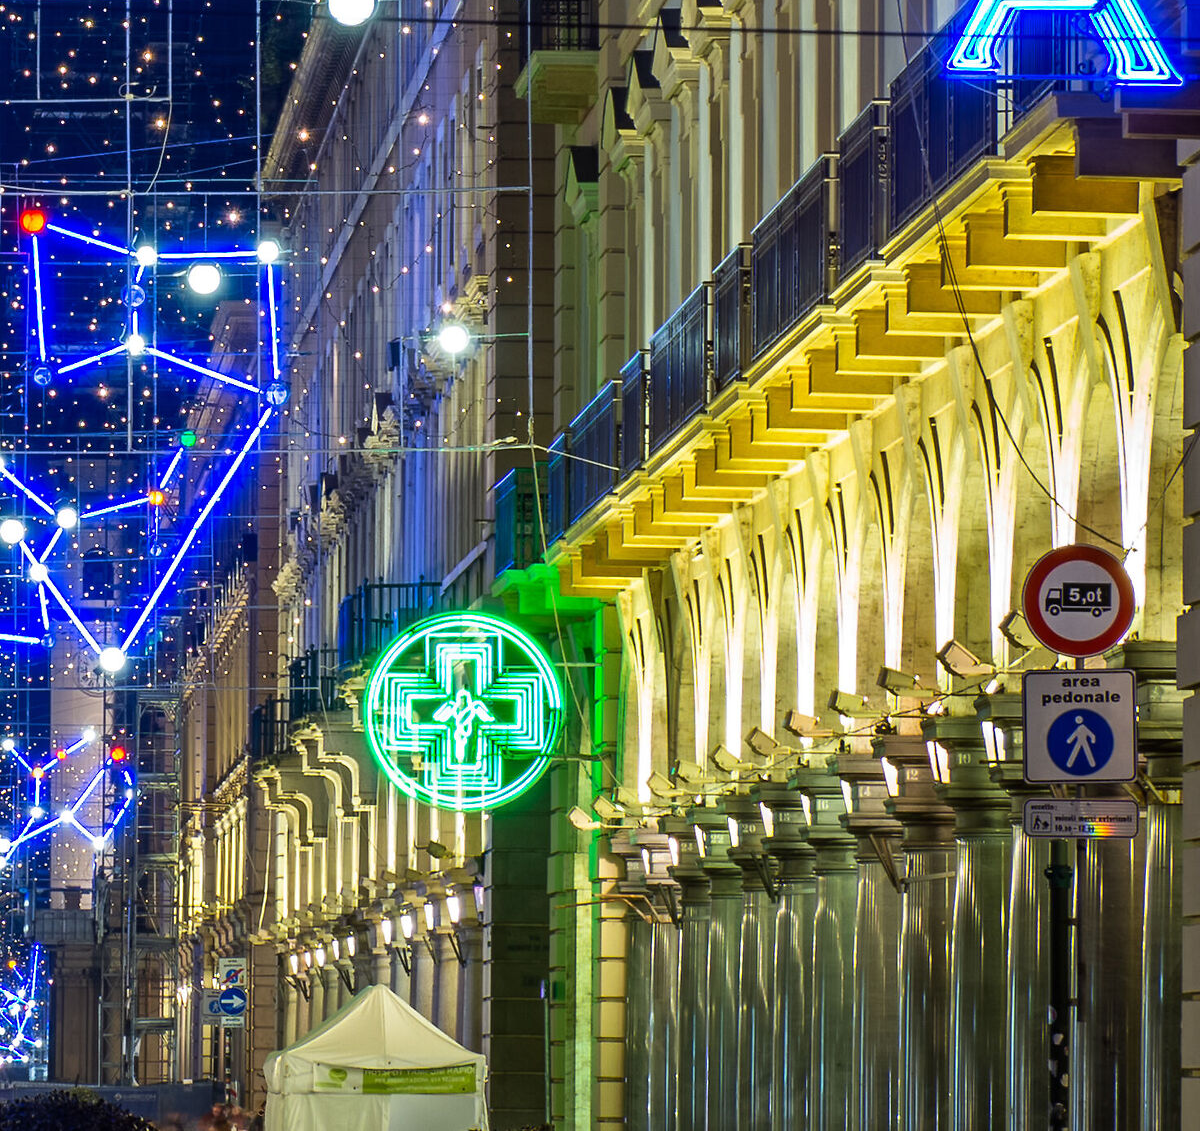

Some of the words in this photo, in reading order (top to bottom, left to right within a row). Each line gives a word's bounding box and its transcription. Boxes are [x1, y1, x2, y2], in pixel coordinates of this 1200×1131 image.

[1061, 677, 1101, 688] area
[1041, 690, 1121, 707] pedonale
[906, 768, 919, 781] 12
